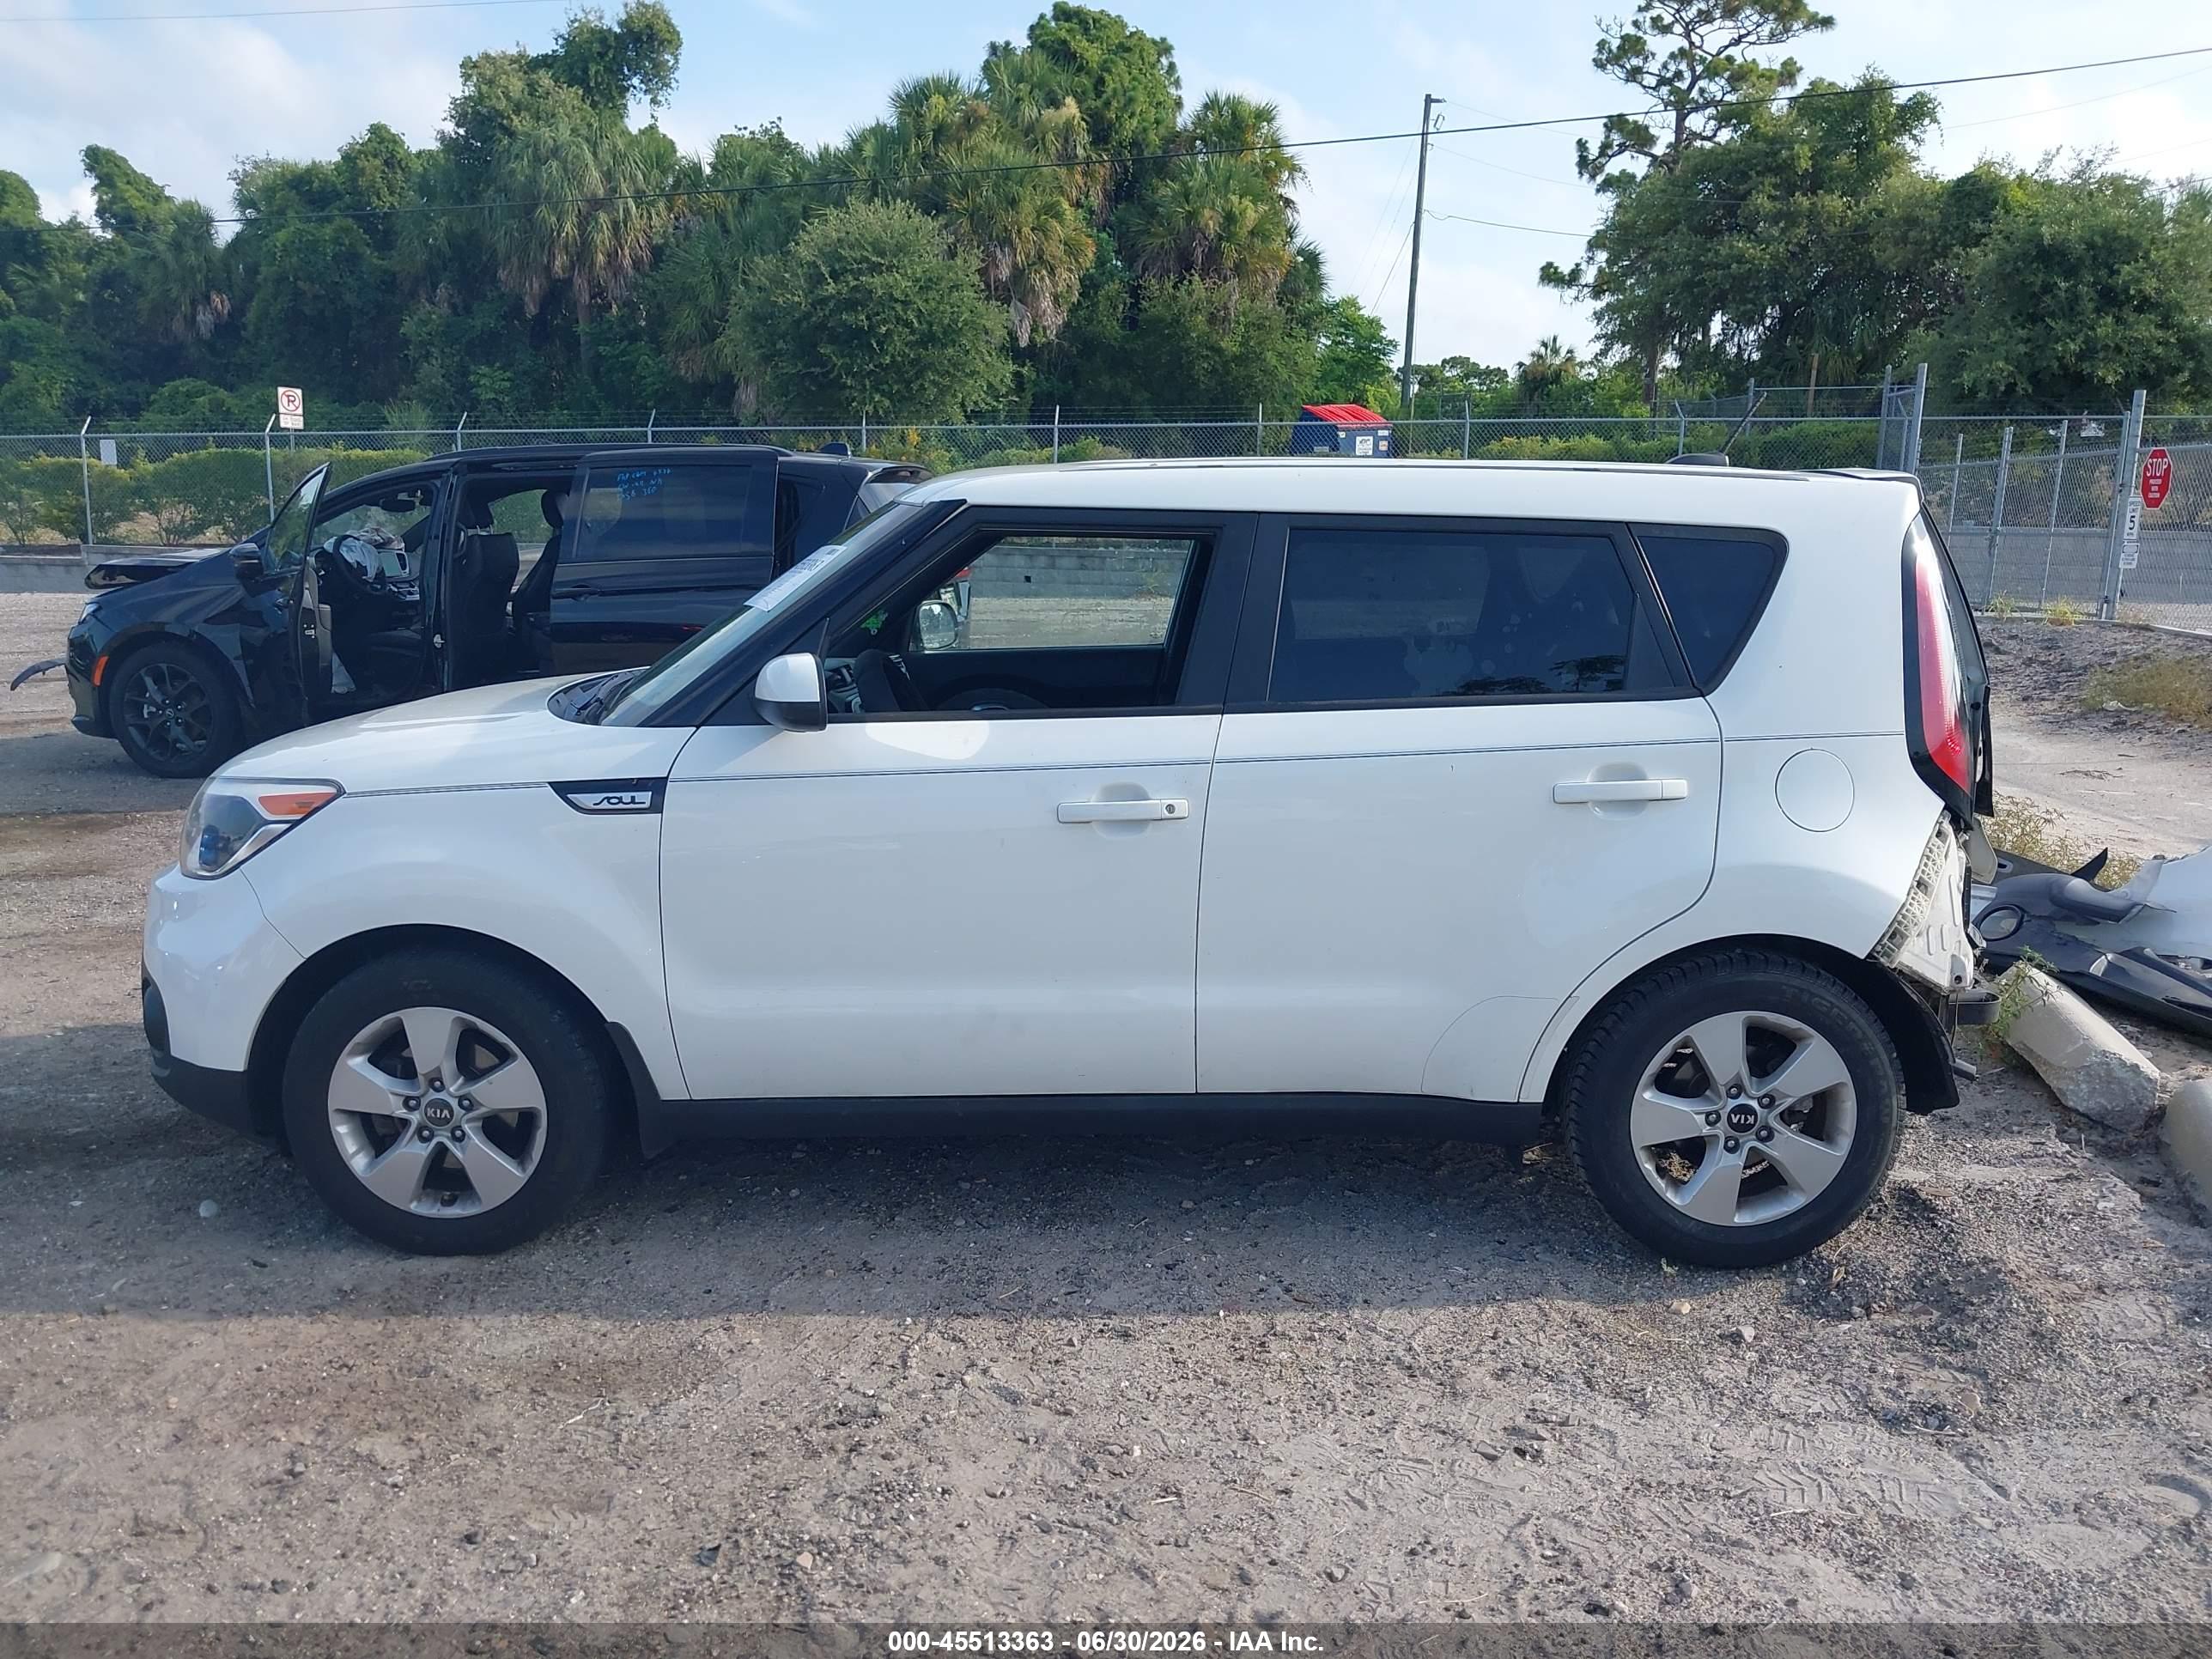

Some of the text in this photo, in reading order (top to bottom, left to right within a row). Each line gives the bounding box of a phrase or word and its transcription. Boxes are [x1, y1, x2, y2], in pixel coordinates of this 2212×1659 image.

[2147, 458, 2169, 477] STOP
[2129, 515, 2136, 531] 5
[592, 795, 647, 806] SOUL
[427, 1107, 451, 1119] KIA
[1730, 1113, 1755, 1125] KIA
